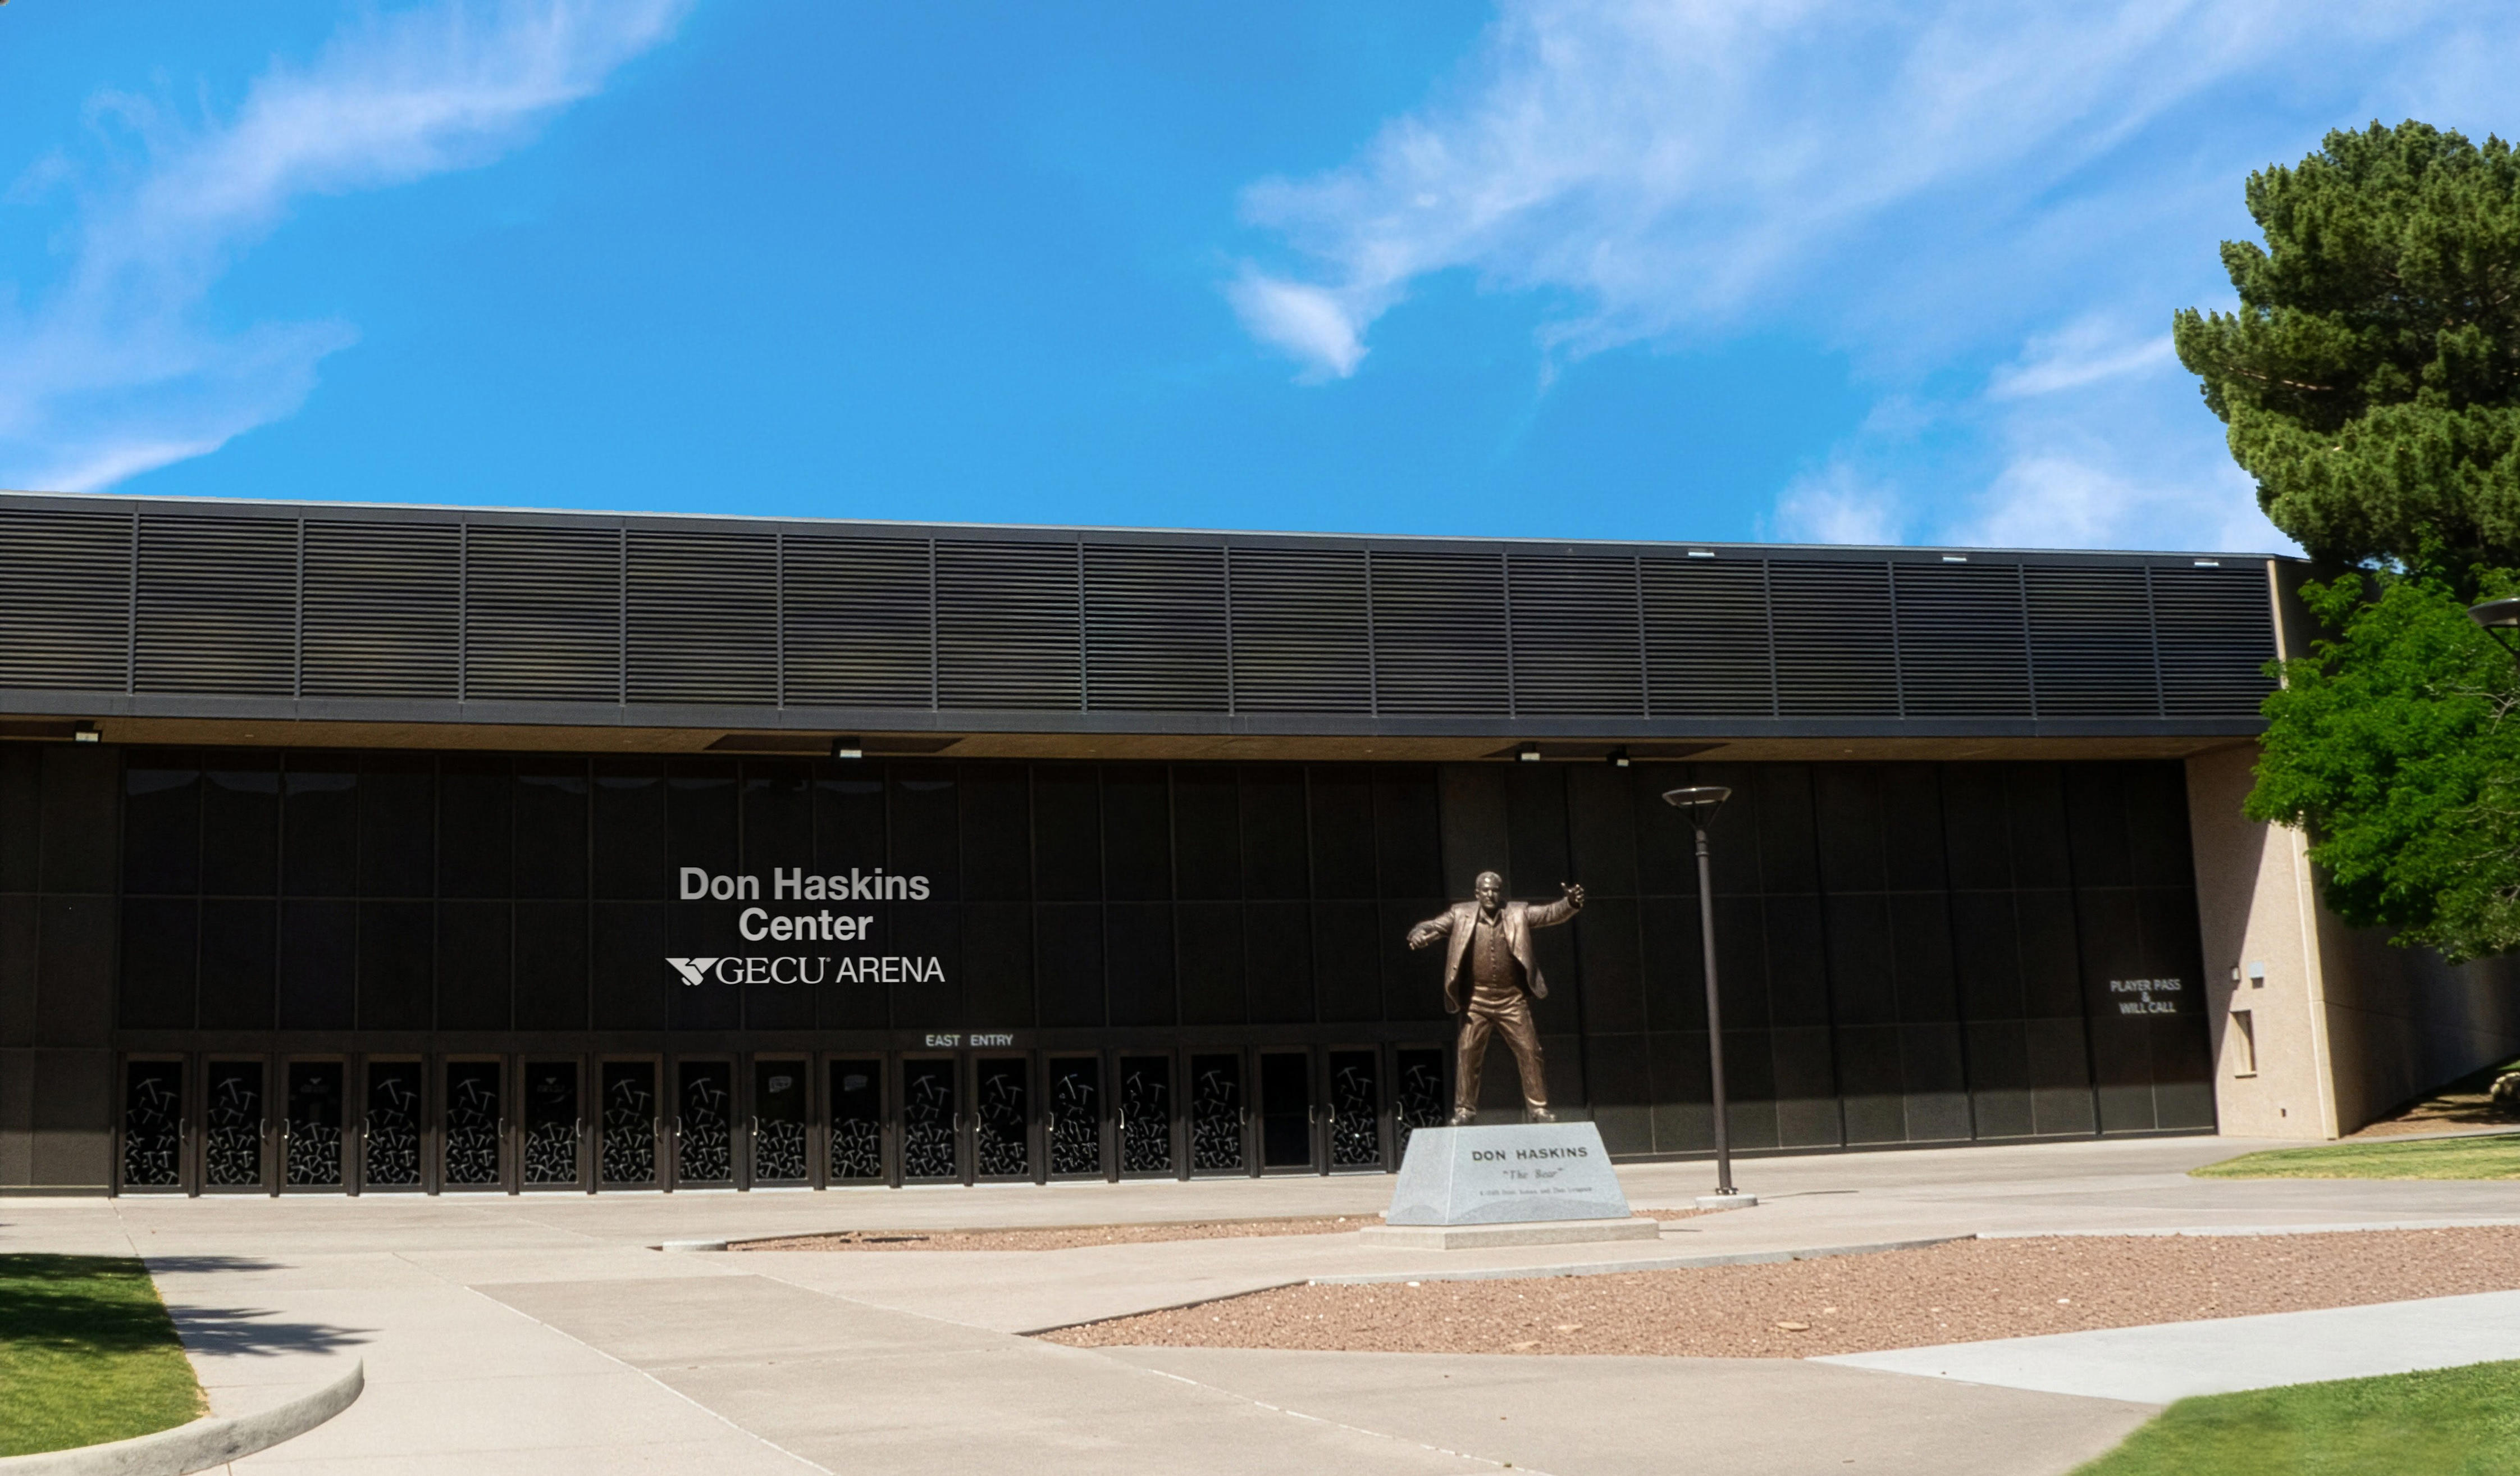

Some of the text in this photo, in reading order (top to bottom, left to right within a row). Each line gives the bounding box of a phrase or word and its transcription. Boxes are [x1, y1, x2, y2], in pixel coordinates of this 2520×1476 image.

[680, 867, 930, 900] Don Haskins
[739, 907, 874, 941] Center
[715, 956, 946, 985] GECU ARENA
[2110, 978, 2181, 992] PLAYER PASS
[2142, 992, 2151, 1002] &
[2119, 1001, 2176, 1014] WILL CALL
[925, 1034, 1013, 1047] EAST ENTRY
[1472, 1147, 1587, 1161] DON HASKINS
